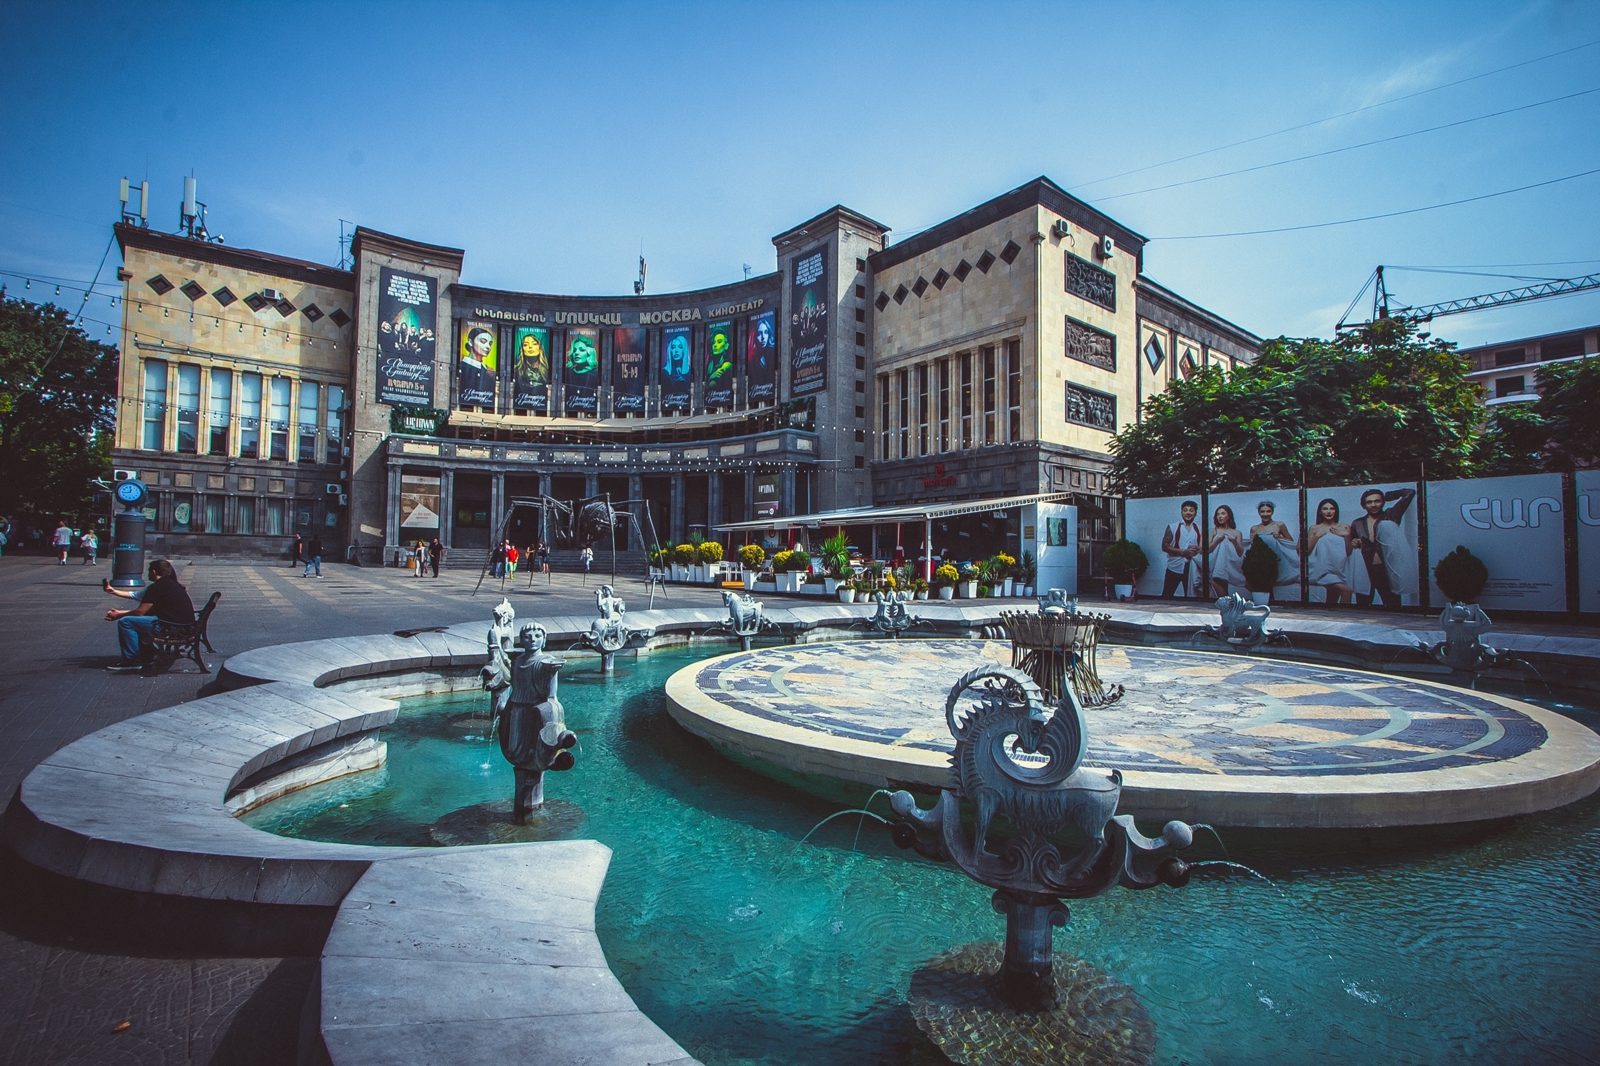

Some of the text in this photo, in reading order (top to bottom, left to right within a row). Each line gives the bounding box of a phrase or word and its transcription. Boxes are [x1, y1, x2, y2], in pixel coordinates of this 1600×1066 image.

[475, 307, 622, 325] ԿԻՆՈԹԱՏՐՈՆ ՄՈՍԿՎԱ
[639, 307, 702, 325] МОСКВА
[708, 298, 764, 318] КИНОТЕАТР
